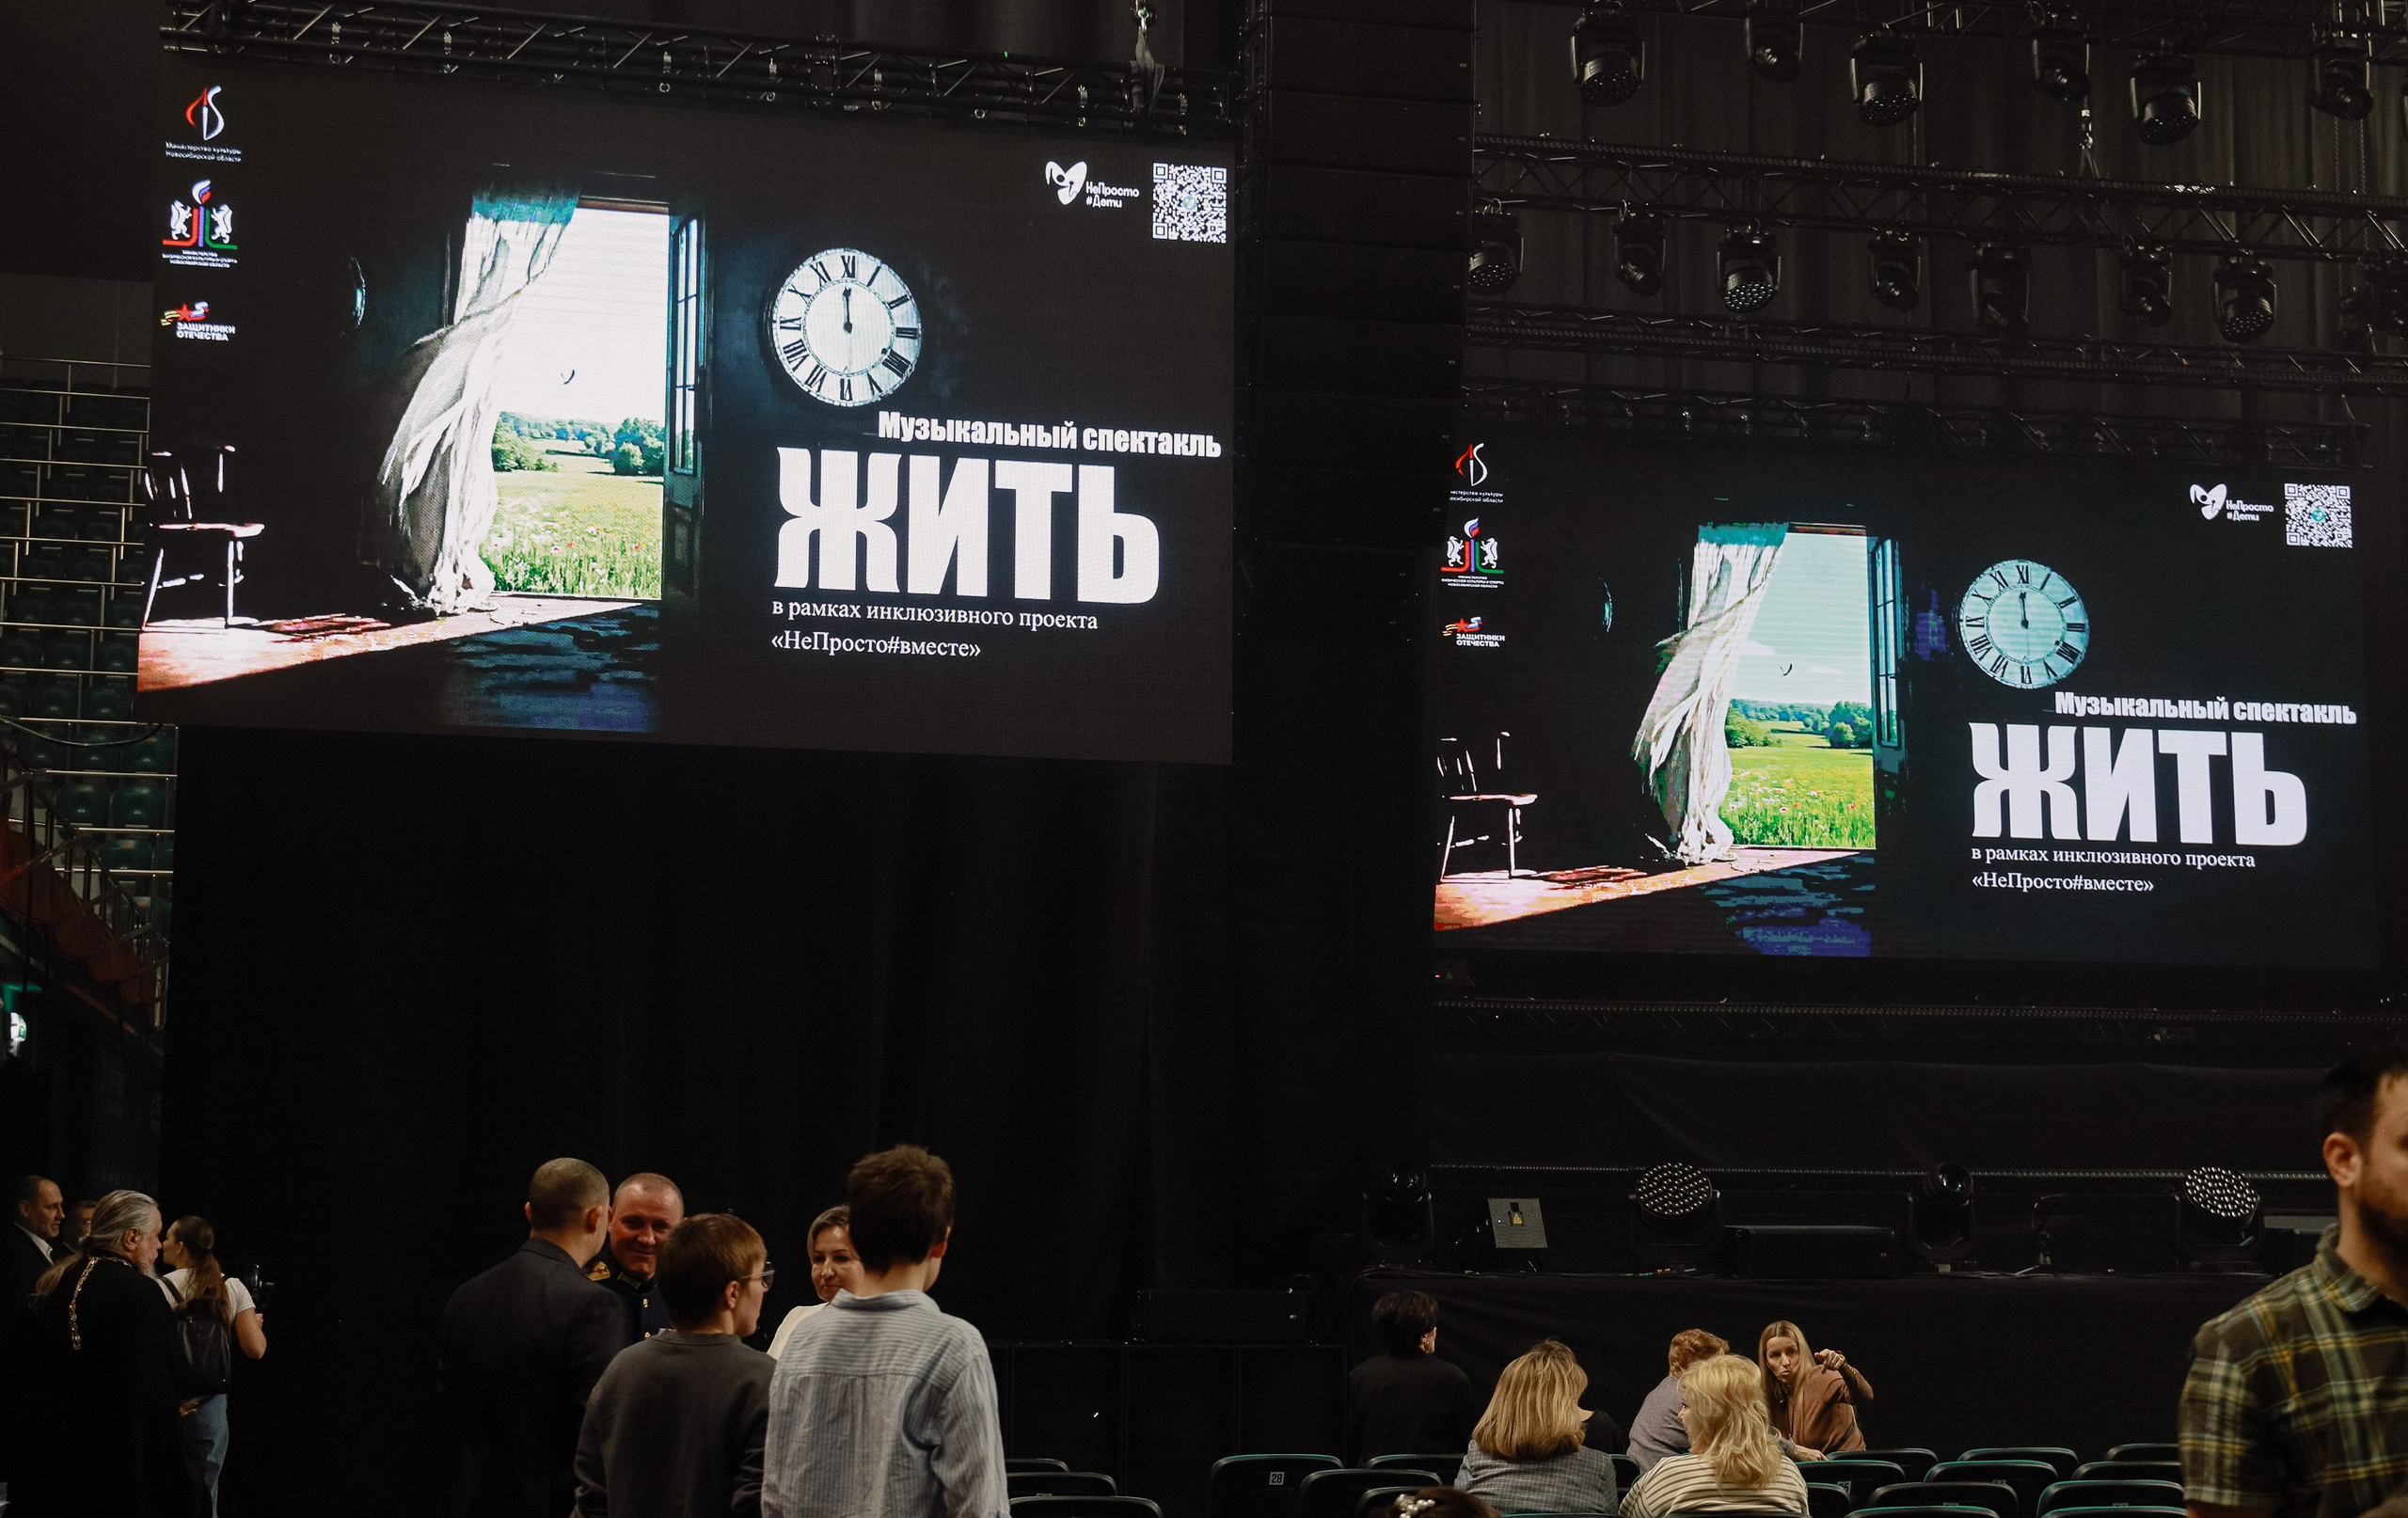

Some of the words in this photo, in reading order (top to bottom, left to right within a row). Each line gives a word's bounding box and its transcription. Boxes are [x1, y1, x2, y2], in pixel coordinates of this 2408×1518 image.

[1085, 182, 1139, 198] НеПросто
[1085, 195, 1122, 208] #Дети
[176, 322, 235, 334] ЗАЩИТНИКИ
[176, 330, 229, 340] ОТЕЧЕСТВА
[878, 410, 1078, 450] Музыкальный
[1083, 427, 1222, 458] спектакль
[2226, 499, 2274, 514] НеПросто
[773, 446, 1160, 605] ЖИТЬ
[2226, 512, 2259, 521] #Дети
[772, 600, 784, 615] в
[788, 602, 862, 622] рамках
[866, 605, 1014, 625] инклюзивного
[1019, 611, 1099, 631] проекта
[771, 629, 981, 658] «НеПросто#вместе»
[1456, 633, 1506, 641] ЗАЩИТНИКИ
[2054, 691, 2230, 721] Музыкальный
[2233, 702, 2357, 724] спектакль
[1969, 722, 2307, 846] ЖИТЬ
[1972, 847, 1982, 861] в
[1986, 848, 2050, 864] рамках
[2052, 850, 2182, 867] инклюзивного
[2185, 853, 2256, 870] проекта
[1972, 871, 2154, 893] «НеПросто#вместе»
[1271, 1473, 1283, 1484] 28
